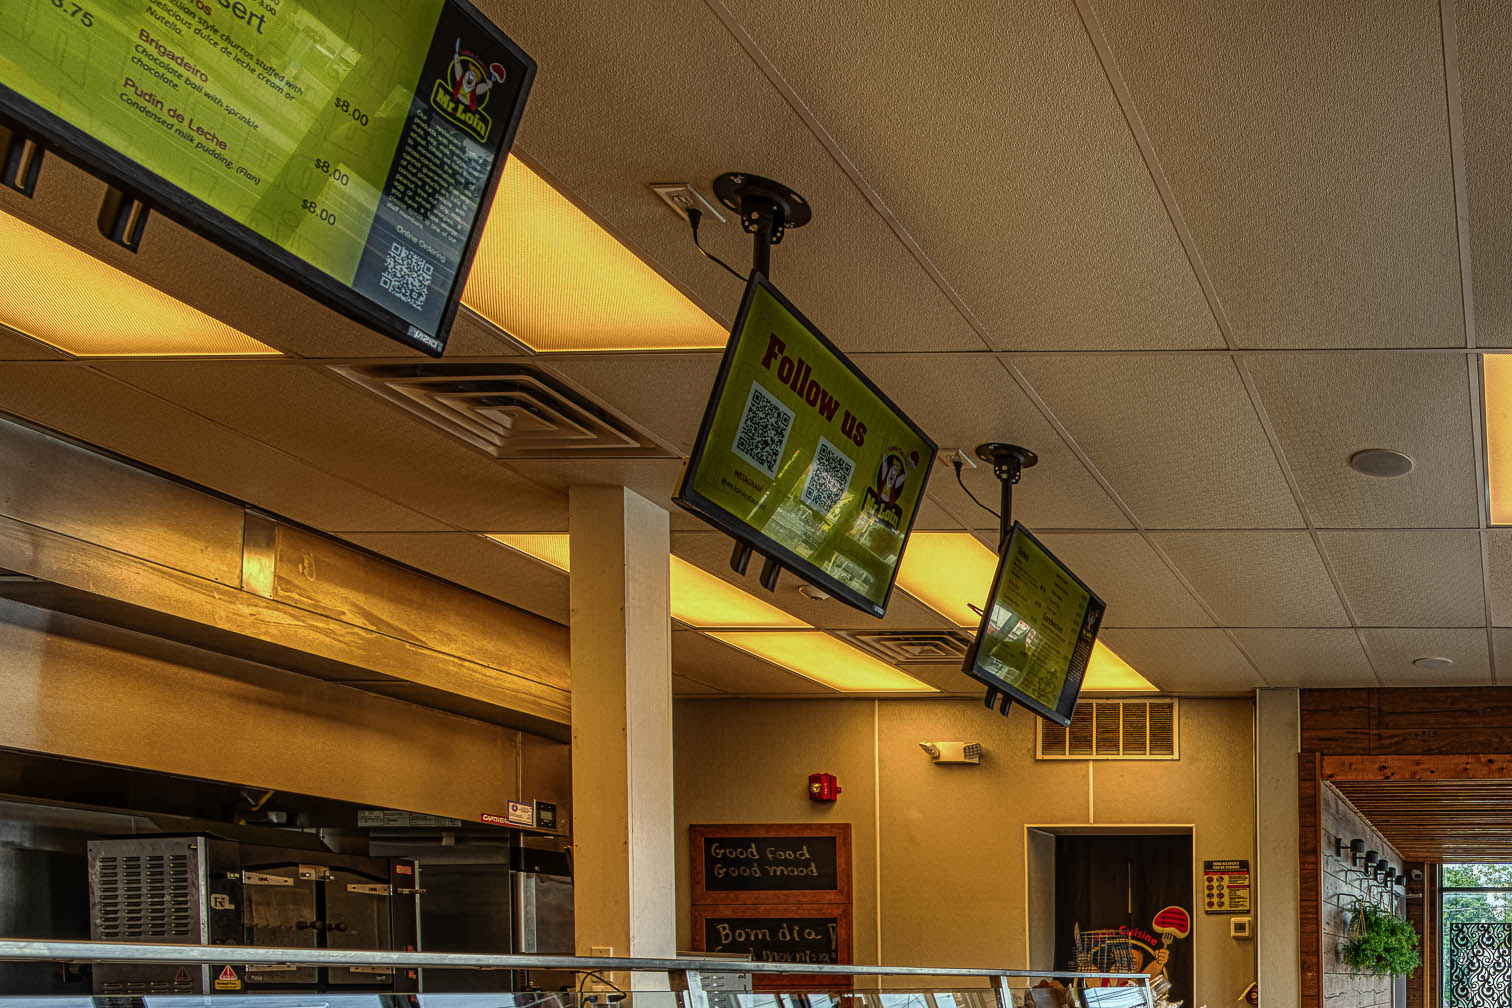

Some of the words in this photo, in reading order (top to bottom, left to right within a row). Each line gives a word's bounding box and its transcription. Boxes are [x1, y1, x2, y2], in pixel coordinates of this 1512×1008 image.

[131, 56, 180, 91] chocolate.
[139, 28, 209, 83] Brigadeiro
[334, 97, 369, 126] $8.00
[194, 27, 219, 49] dulce
[220, 45, 233, 58] de
[233, 53, 256, 75] leche
[257, 72, 284, 95] cream
[285, 92, 295, 102] or
[220, 32, 254, 60] churros
[256, 57, 286, 82] stuffed
[285, 79, 303, 96] with
[135, 44, 184, 80] Chocolate
[184, 77, 203, 94] ball
[204, 91, 224, 109] with
[223, 104, 259, 131] sprinkle
[119, 92, 173, 131] Condensed
[174, 126, 195, 145] milk
[196, 140, 234, 170] pudding.
[235, 165, 262, 186] (Flan)
[124, 77, 164, 112] Pudin
[167, 106, 185, 124] de
[188, 117, 228, 150] Leche
[314, 158, 349, 186] $8.00
[456, 103, 487, 137] Loin
[301, 199, 336, 226] $8.00
[397, 225, 419, 243] Online
[420, 240, 447, 263] Ordering
[761, 332, 840, 424] Follow
[840, 408, 868, 448] us
[711, 842, 760, 859] Good
[713, 862, 762, 878] Good
[766, 862, 819, 876] mood
[715, 923, 771, 944] Bom
[778, 923, 823, 941] dia
[1119, 925, 1157, 946] Cuisine
